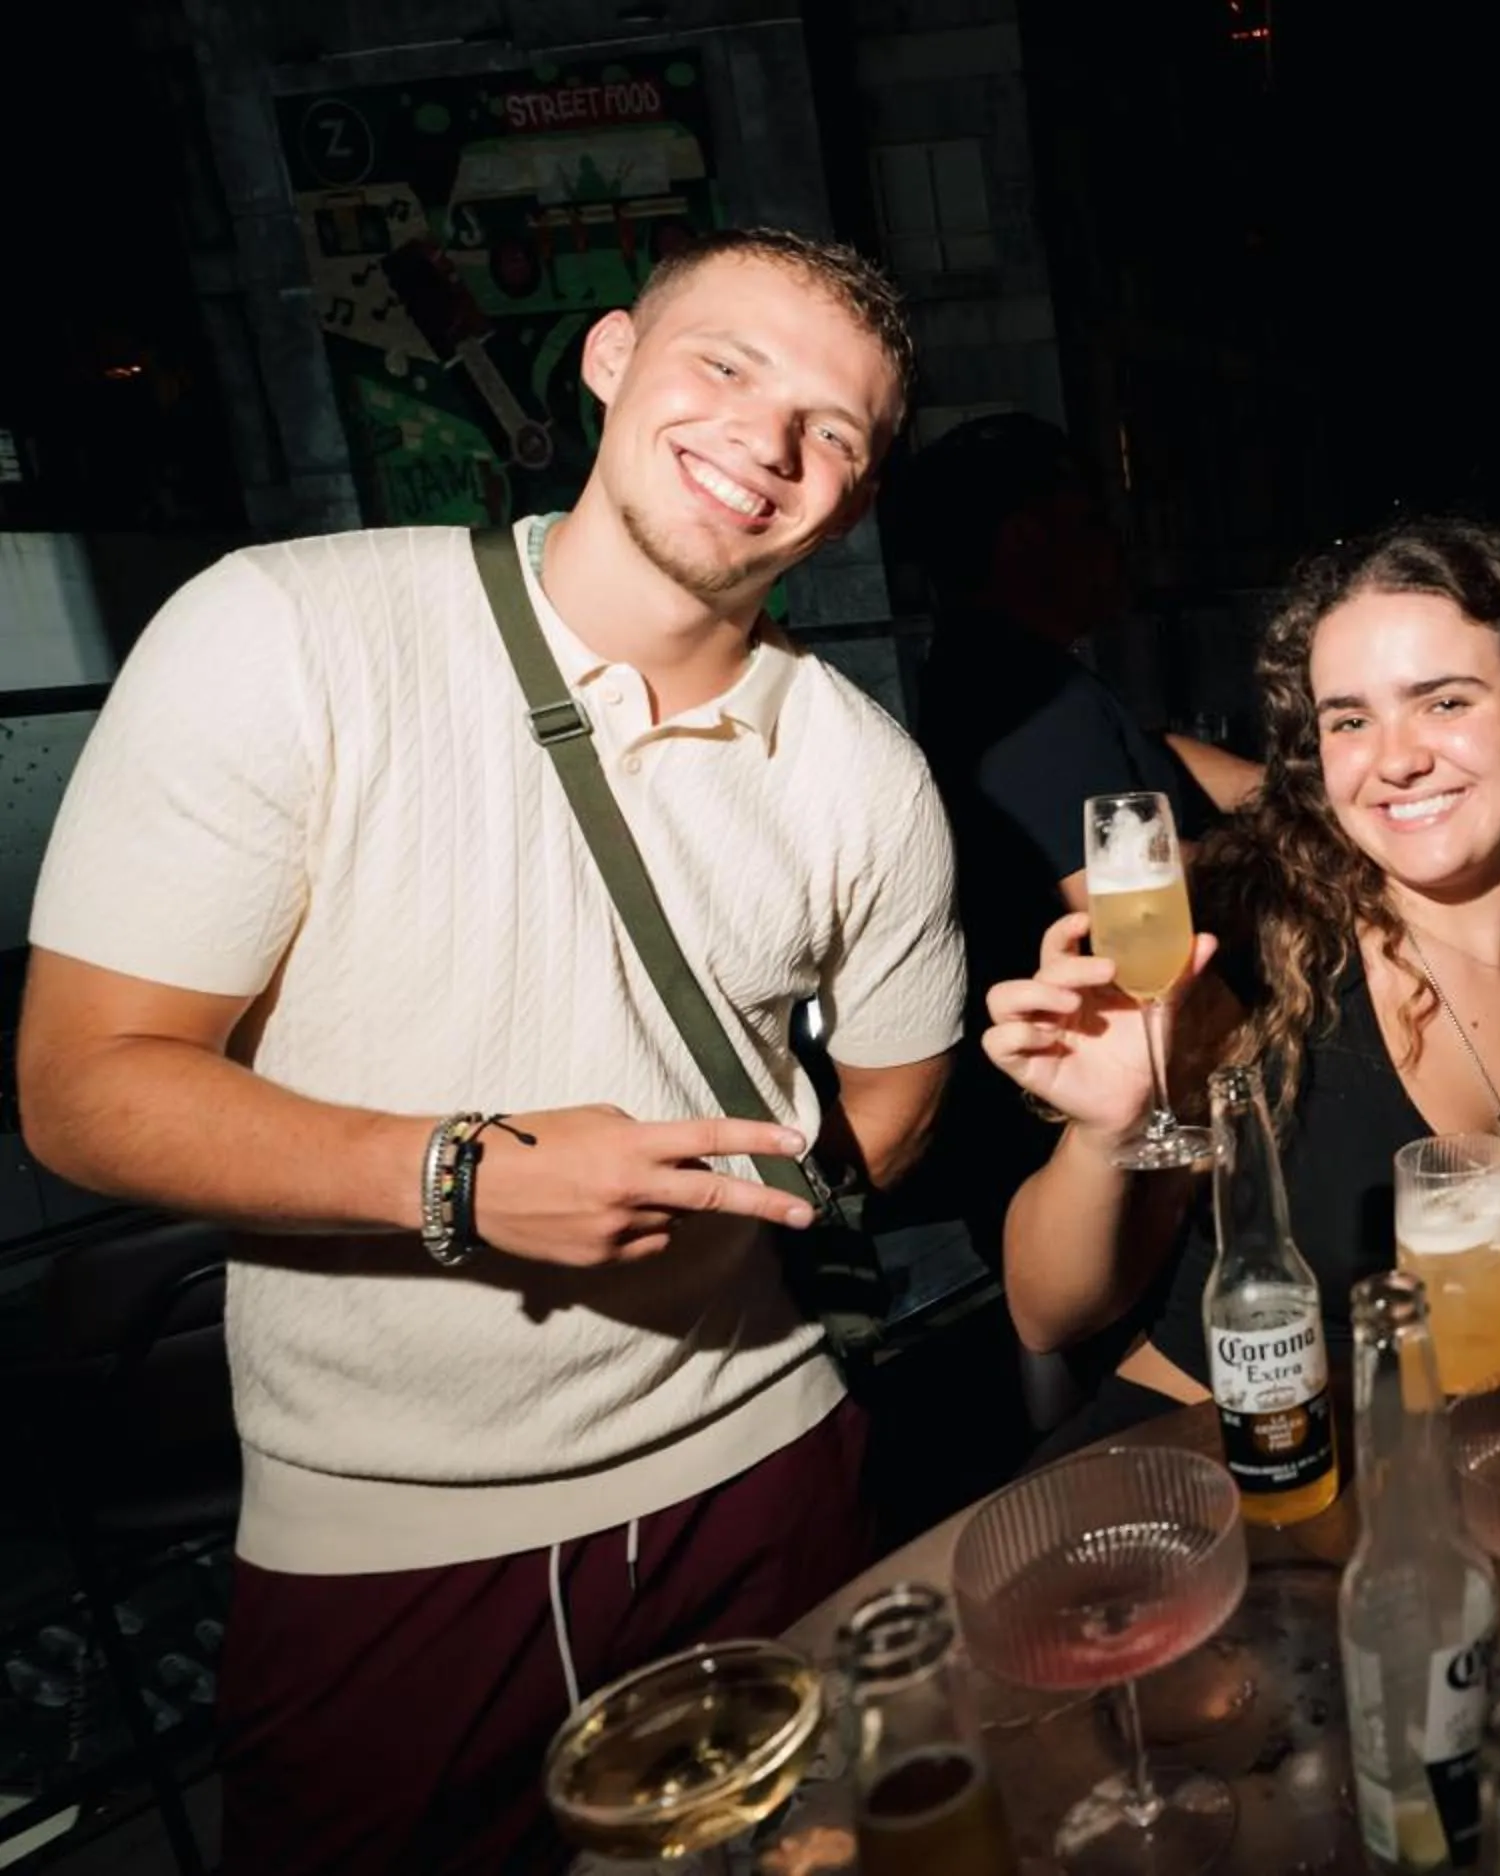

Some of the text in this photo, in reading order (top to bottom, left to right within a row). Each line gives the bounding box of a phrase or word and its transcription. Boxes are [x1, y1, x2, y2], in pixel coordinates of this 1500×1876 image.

[505, 81, 662, 127] STREET FOOD
[317, 117, 355, 158] Z
[1218, 1326, 1317, 1369] Corona
[1247, 1363, 1303, 1384] Extra
